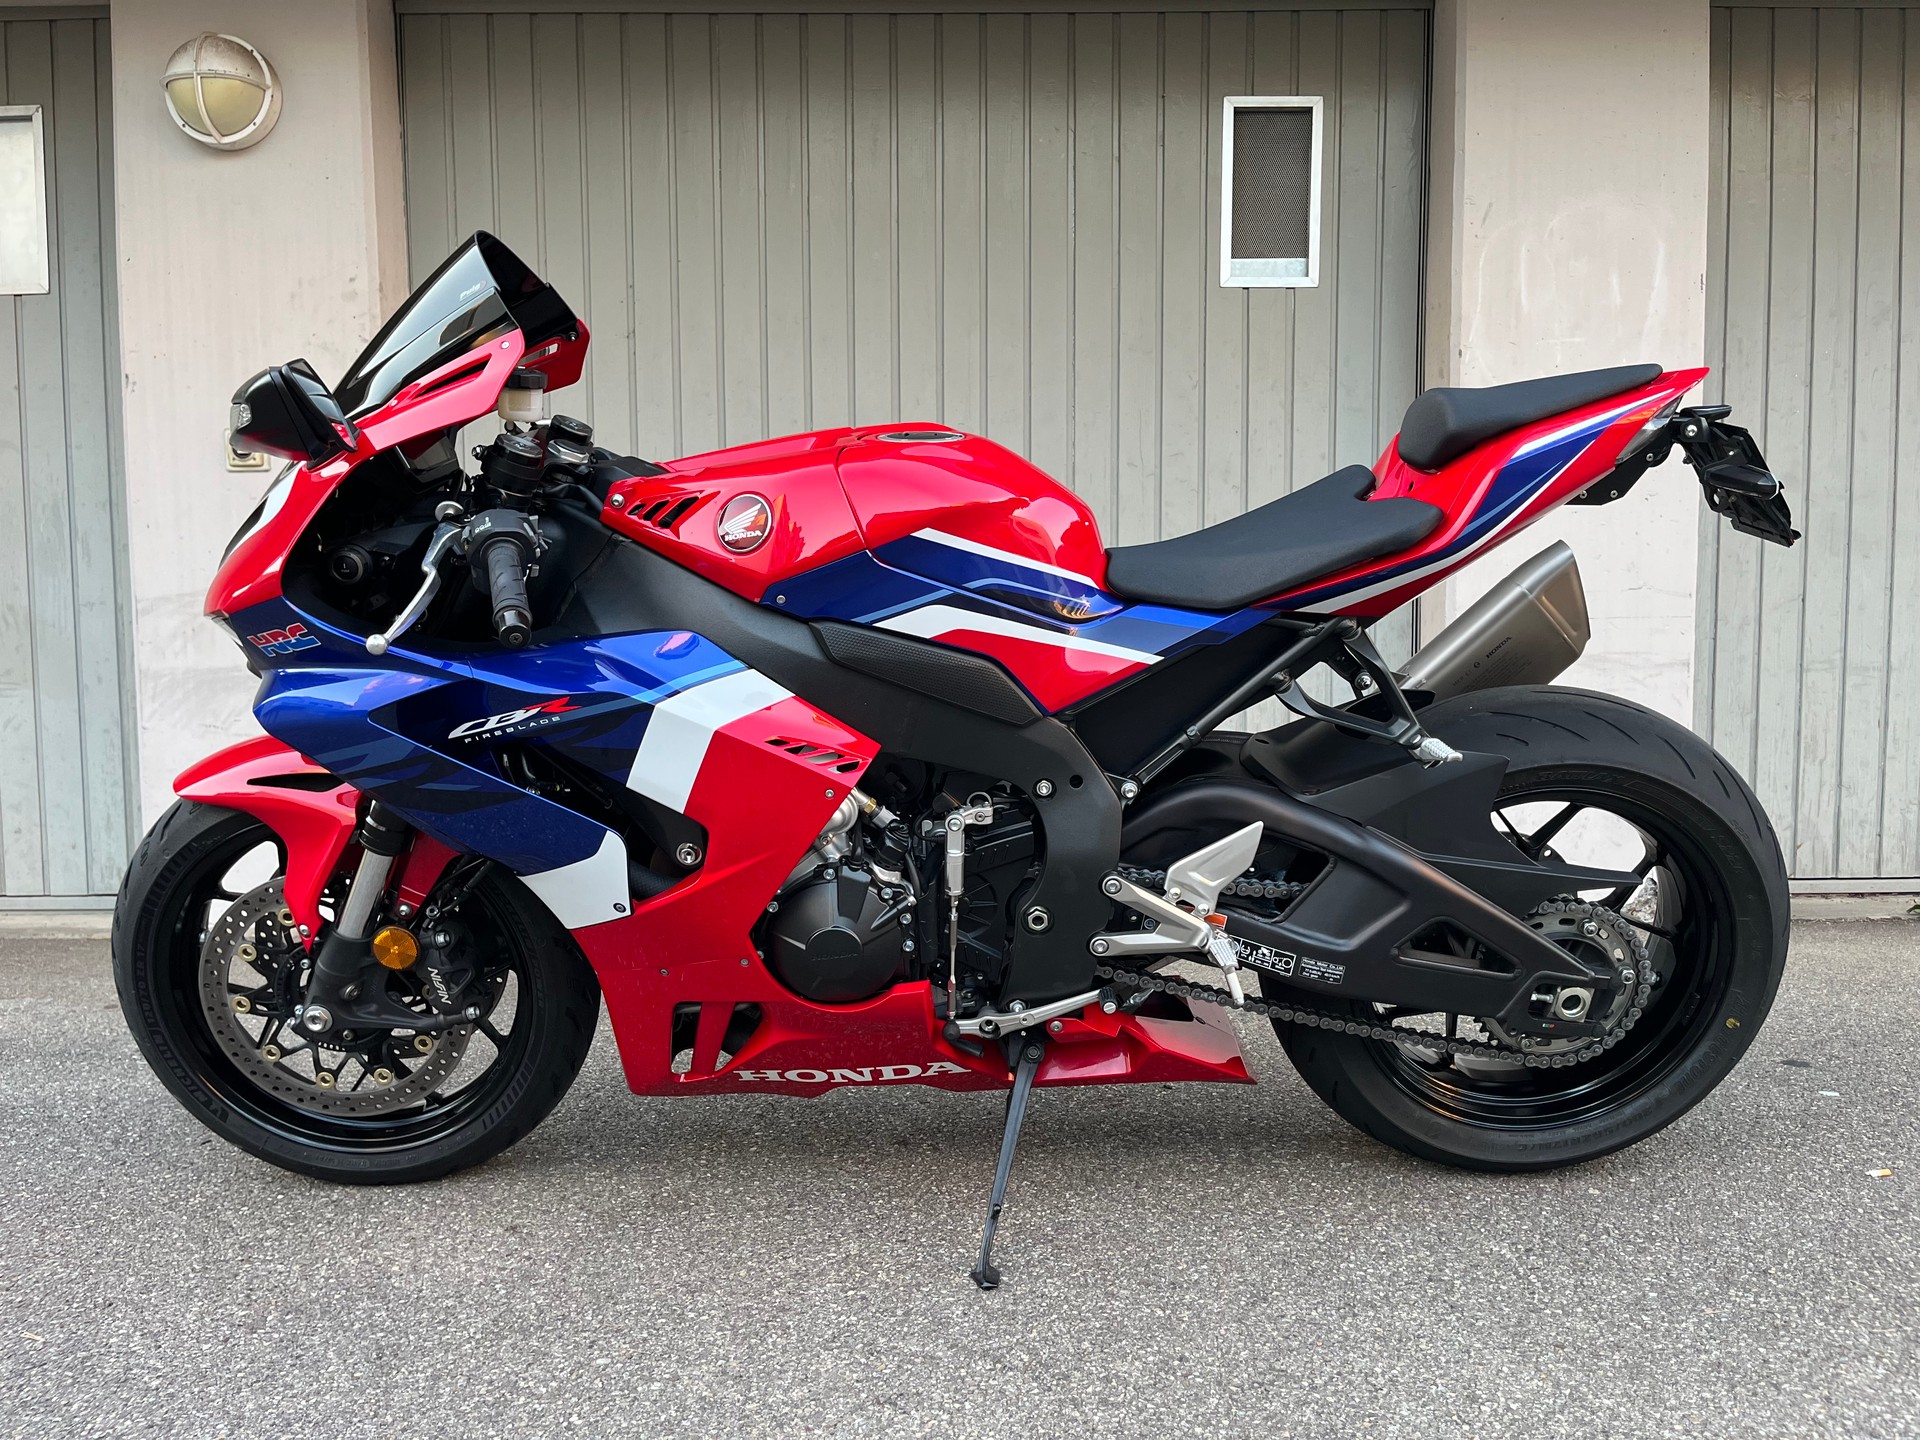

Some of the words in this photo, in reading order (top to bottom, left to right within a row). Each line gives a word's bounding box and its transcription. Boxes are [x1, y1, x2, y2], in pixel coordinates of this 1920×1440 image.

[724, 530, 763, 541] HONDA
[246, 622, 321, 657] HRC
[1486, 635, 1512, 659] HONDA
[448, 696, 583, 739] CBR
[464, 716, 561, 743] FIREBLADE
[733, 1061, 972, 1083] HONDA
